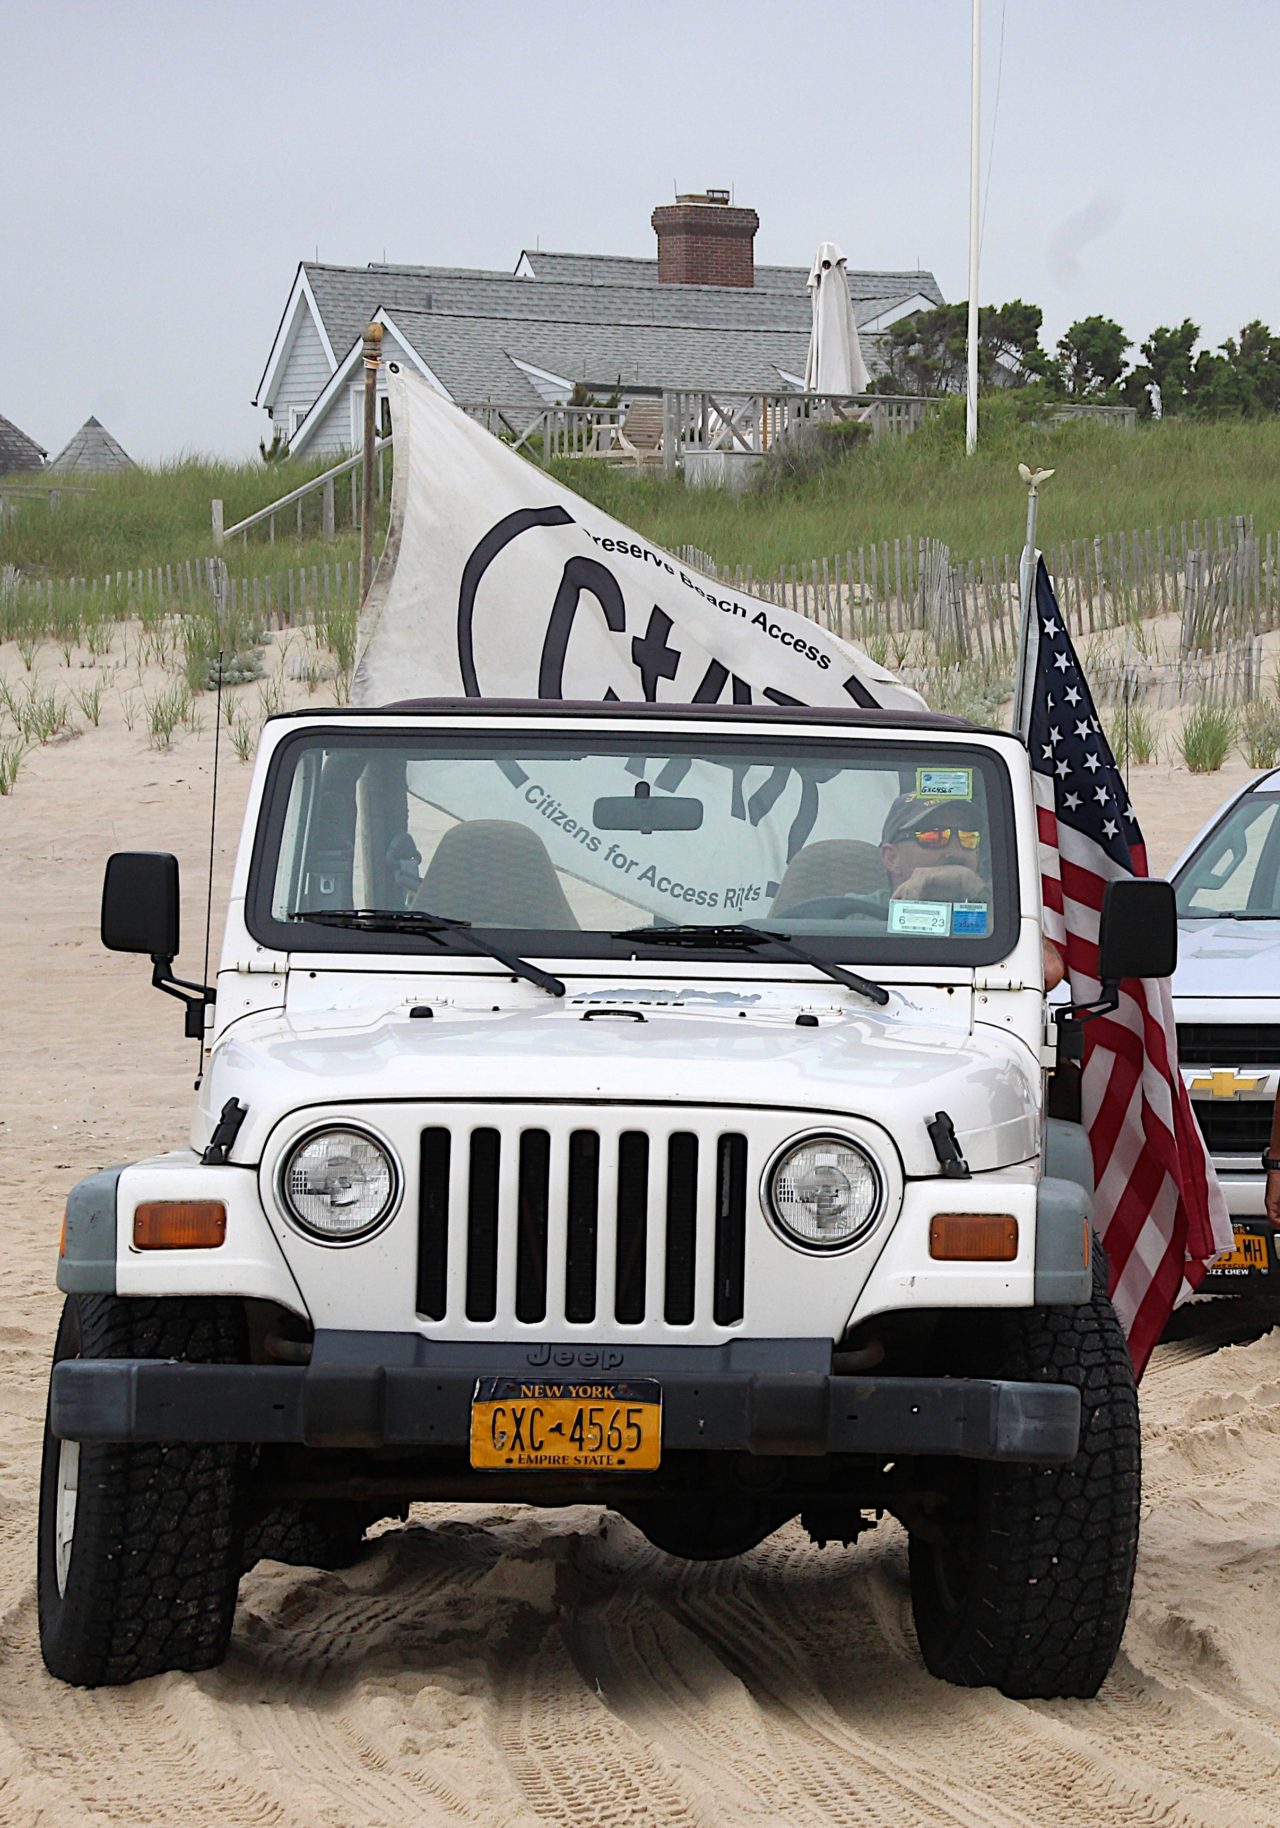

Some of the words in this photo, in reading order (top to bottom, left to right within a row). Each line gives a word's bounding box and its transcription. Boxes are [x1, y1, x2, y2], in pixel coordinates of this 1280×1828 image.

[582, 528, 675, 575] reserve
[680, 570, 748, 618] Beach
[751, 611, 832, 670] Access
[524, 784, 603, 853] Citizens
[604, 844, 640, 874] for
[637, 865, 719, 908] Access
[898, 915, 906, 925] 6
[931, 918, 945, 928] 23
[527, 1344, 624, 1370] Jeep
[521, 1384, 564, 1399] NEW
[569, 1384, 616, 1400] YORK
[491, 1407, 545, 1452] GXC
[569, 1407, 643, 1453] 4565
[518, 1454, 569, 1466] EMPIRE
[574, 1455, 614, 1466] STATE
